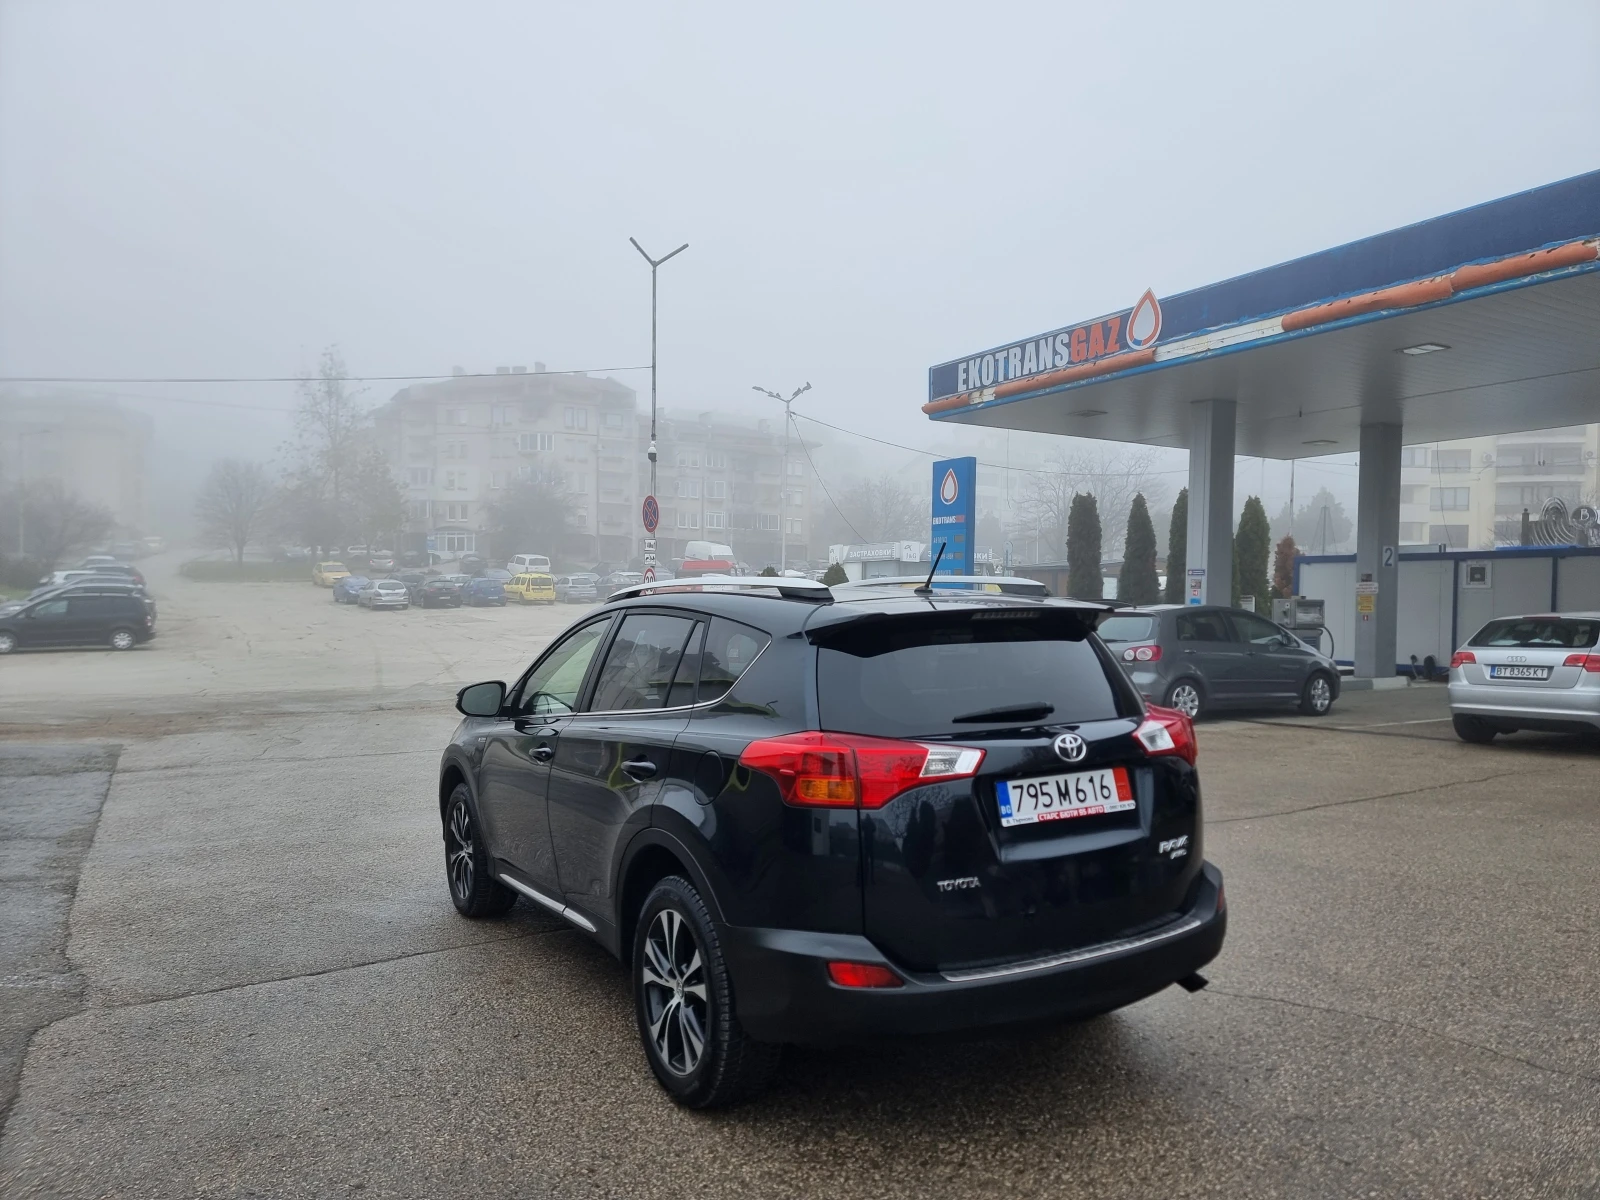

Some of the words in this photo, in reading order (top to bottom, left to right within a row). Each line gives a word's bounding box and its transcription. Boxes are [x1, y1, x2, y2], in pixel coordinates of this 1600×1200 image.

[956, 317, 1121, 393] EKOTRANSGAZ
[932, 514, 965, 525] EKOTRANS
[849, 548, 892, 558] ЗАСТРАХОВКИ
[1384, 547, 1394, 567] 2
[1509, 667, 1532, 677] 8365
[1533, 668, 1547, 677] KT
[1000, 804, 1013, 815] BG
[1038, 812, 1060, 821] СТАРС
[1087, 806, 1104, 815] АВТО
[936, 876, 981, 892] TOYOTA
